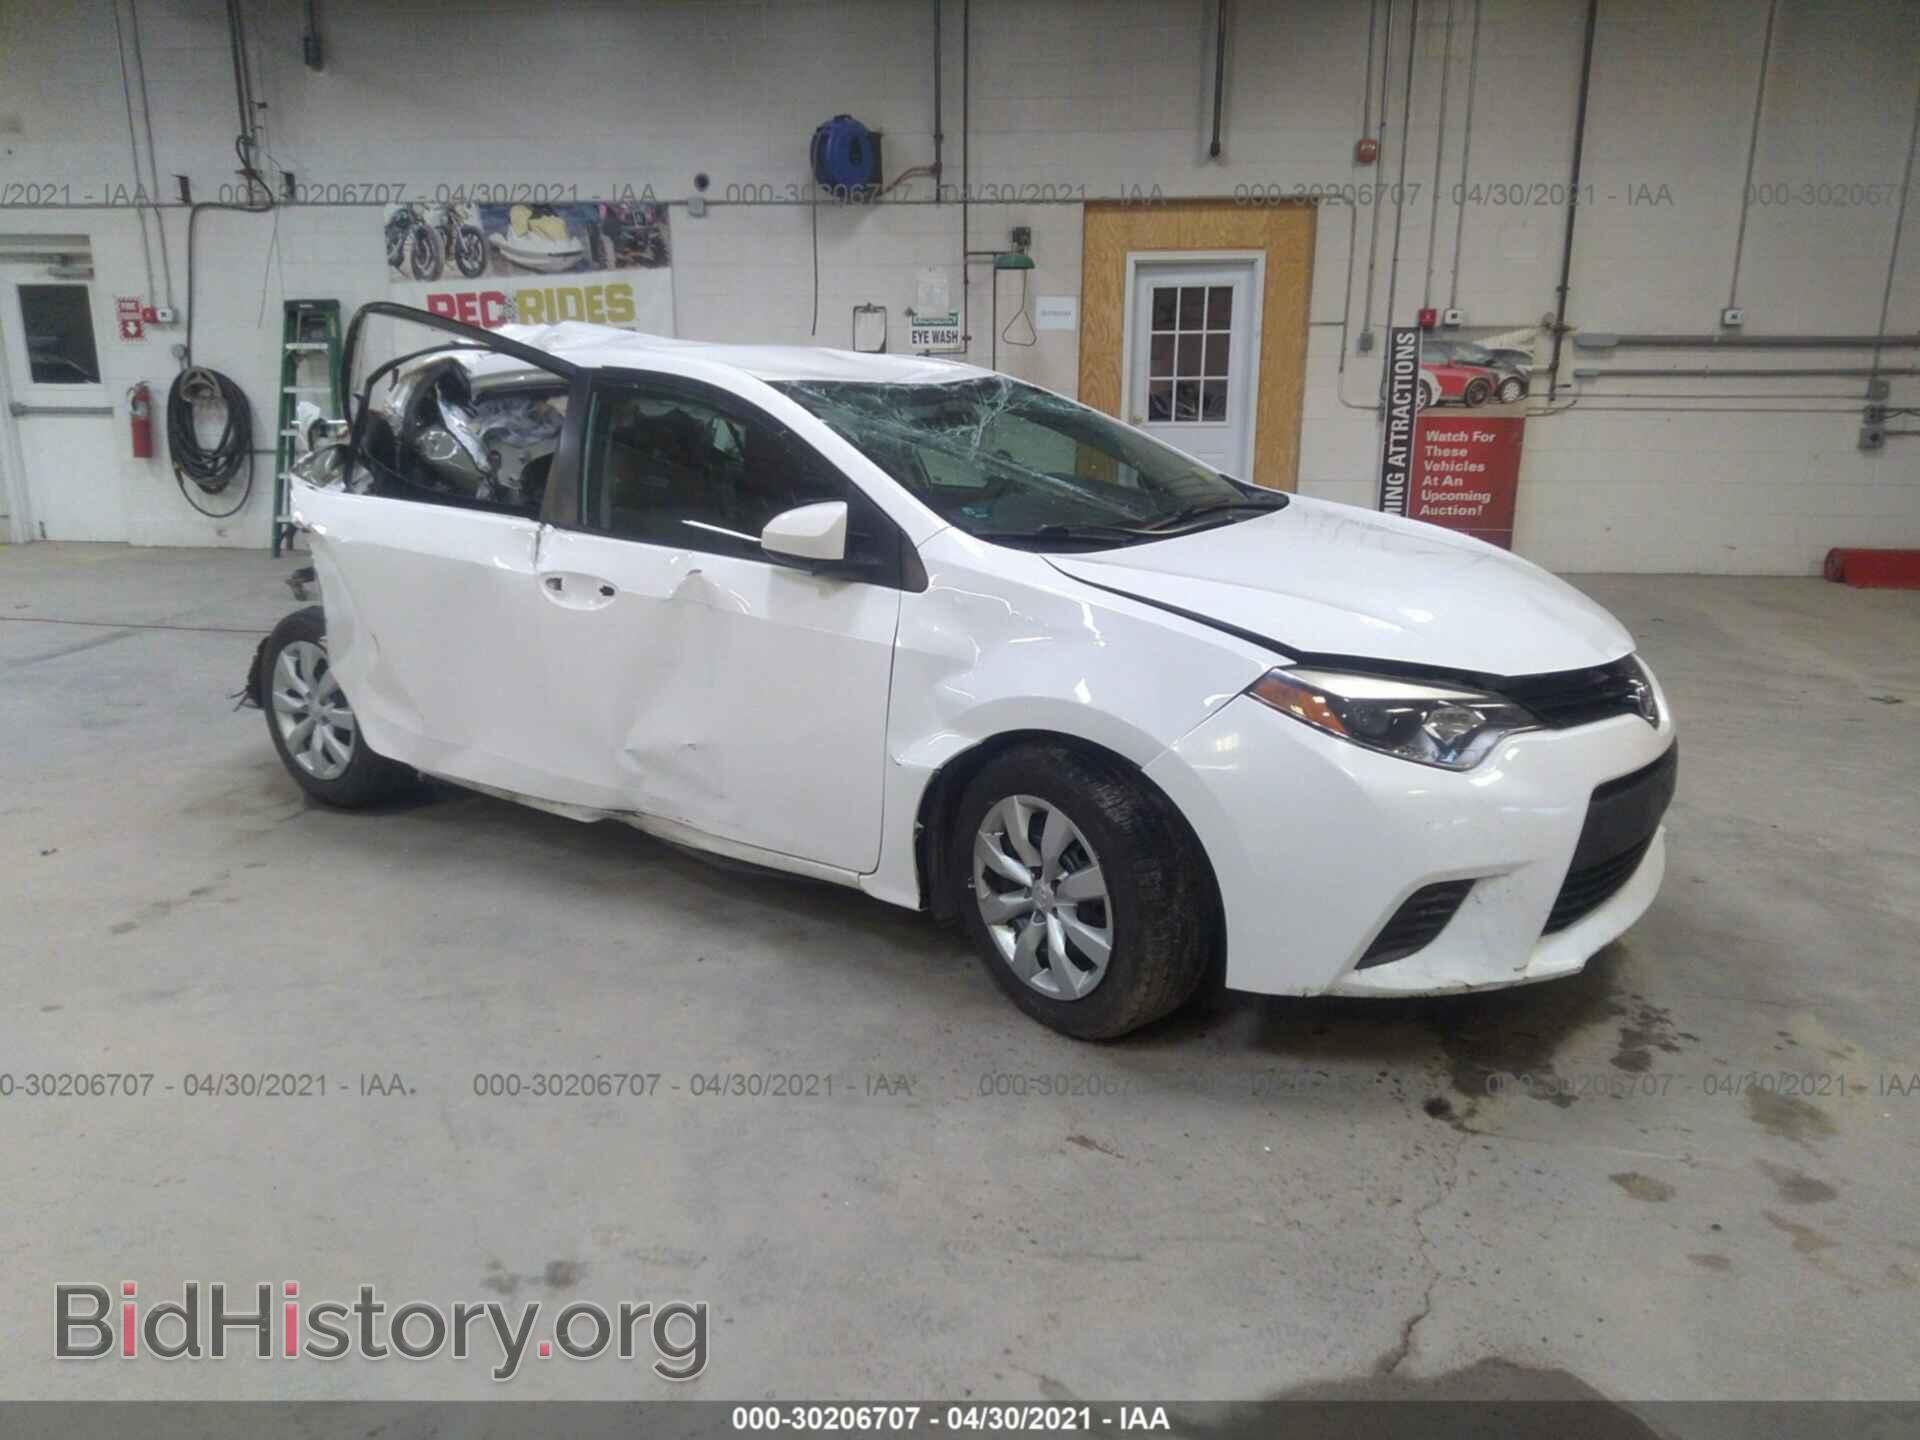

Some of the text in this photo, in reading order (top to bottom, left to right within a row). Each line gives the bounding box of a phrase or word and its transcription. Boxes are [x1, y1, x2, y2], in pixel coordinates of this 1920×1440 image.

[427, 284, 637, 329] REC RIDES
[911, 329, 959, 345] EYE WASH
[1384, 332, 1416, 513] ING ATTRACTIONS
[1426, 430, 1496, 442] Watch For
[1425, 445, 1468, 457] These
[1424, 460, 1485, 472] Vehicles
[1422, 475, 1463, 487] At An
[1421, 490, 1491, 504] Upcoming
[1420, 504, 1483, 516] Auction!
